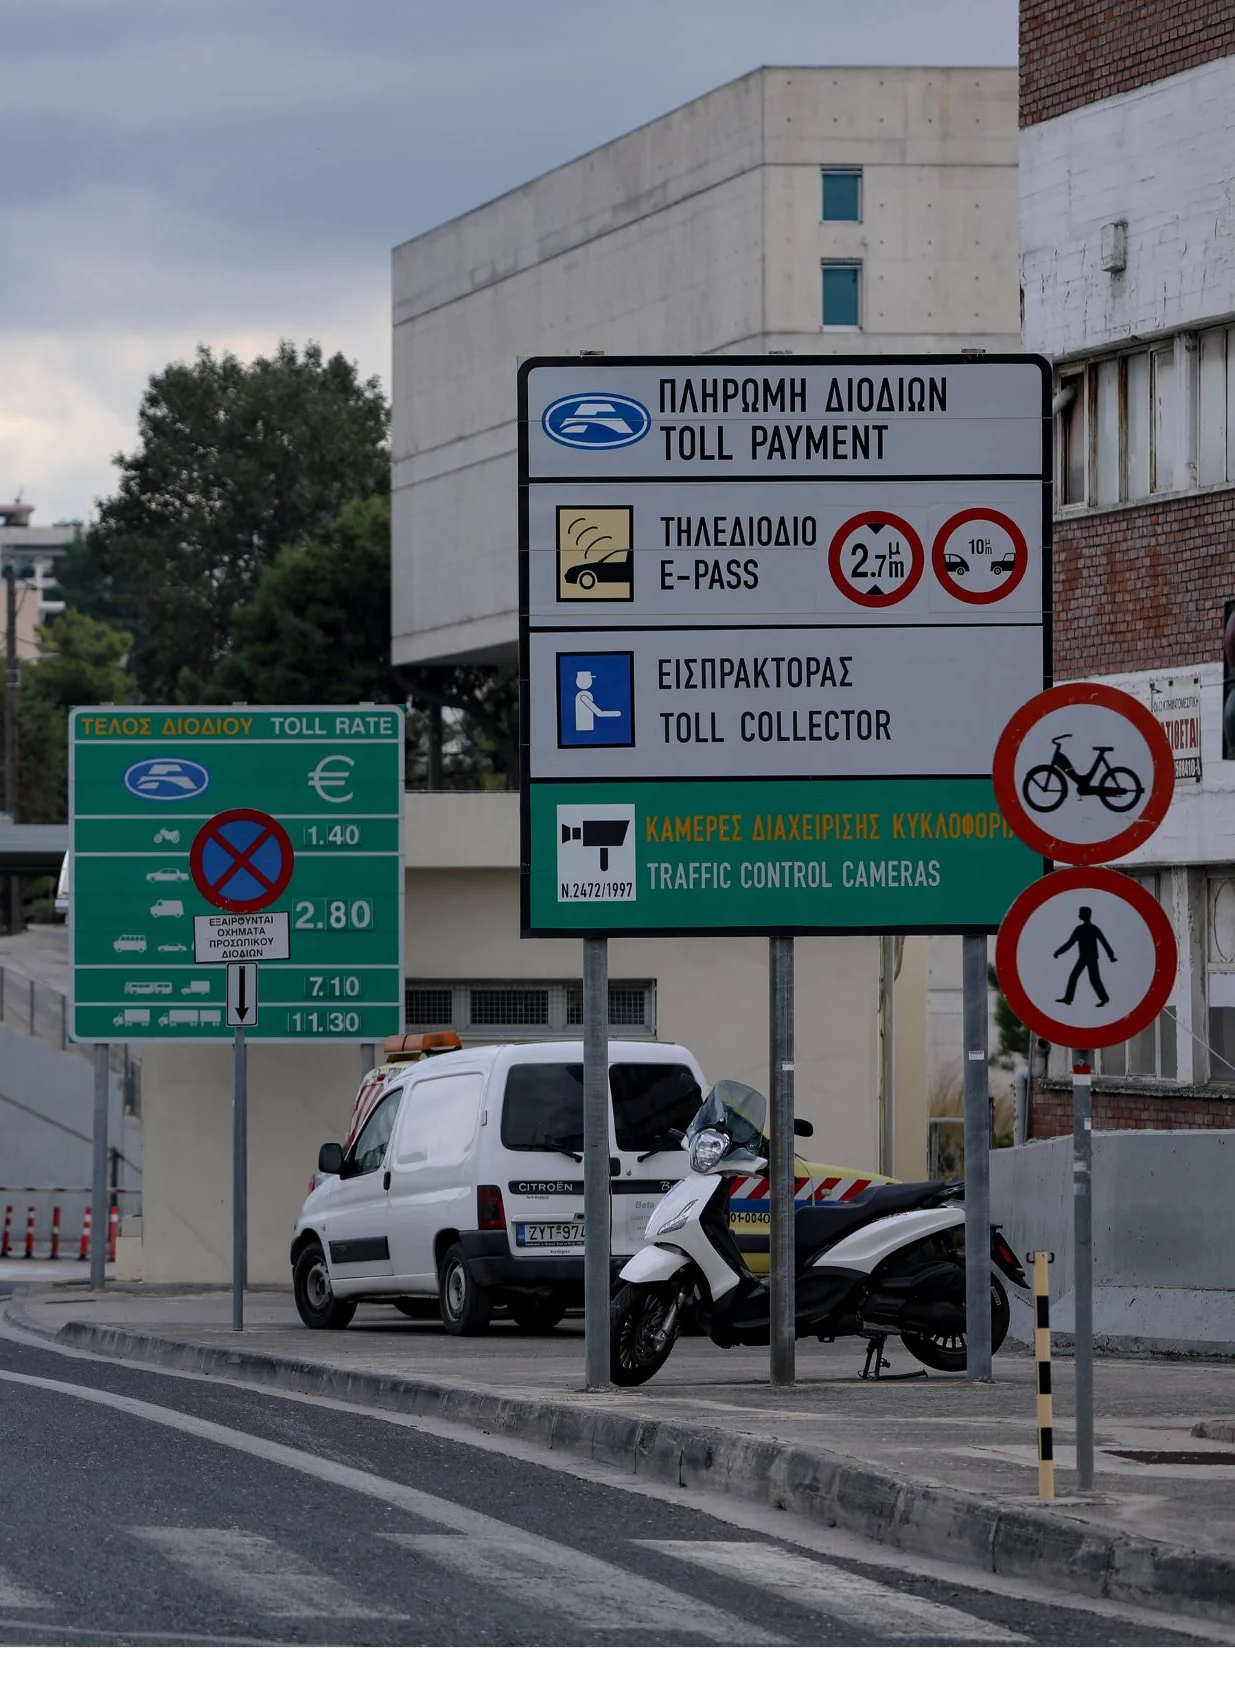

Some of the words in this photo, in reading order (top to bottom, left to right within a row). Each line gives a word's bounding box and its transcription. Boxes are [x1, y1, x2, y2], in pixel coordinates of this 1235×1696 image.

[660, 378, 807, 412] ΠΛΗΡΩΜΗ
[825, 377, 947, 412] ΔΙΟΔΙΩΝ
[660, 425, 733, 460] TOLL
[751, 424, 888, 460] PAYMENT
[660, 515, 817, 547] ΤΗΛΕΔΙΟΔΙΟ
[661, 558, 759, 590] E-PASS
[658, 656, 853, 690] ΕΙΣΠΡΑΚΤΟΡΑΣ
[80, 717, 152, 735] ΤΕΛΟΣ
[162, 717, 254, 735] ΔΙΟΔΙΟΥ
[271, 717, 327, 735] TOLL
[335, 717, 393, 735] RATE
[660, 711, 725, 744] TOLL
[740, 709, 892, 743] COLLECTOR
[308, 755, 355, 803] €
[308, 826, 360, 845] 1.40
[645, 814, 743, 843] ΚΑΜΕΡΕΣ
[752, 812, 881, 842] ΔΙΑΧΕΙΡΙΣΗΣ
[647, 862, 732, 890] TRAFFIC
[740, 861, 833, 889] CONTROL
[842, 859, 941, 888] CAMERAS
[210, 916, 274, 927] ΕΞΑΙΡΟΥΝΤΑΙ
[295, 901, 371, 929] 2.80
[209, 937, 274, 948] ΠΡΟΣΩΠΙΚΟΥ
[217, 927, 266, 937] ΟΧΗΜΑΤΑ
[222, 949, 264, 959] ΔΙΟΔΙΩΝ
[310, 977, 360, 996] 7.10
[292, 1013, 360, 1032] 11.30
[518, 1181, 573, 1192] CITROËN
